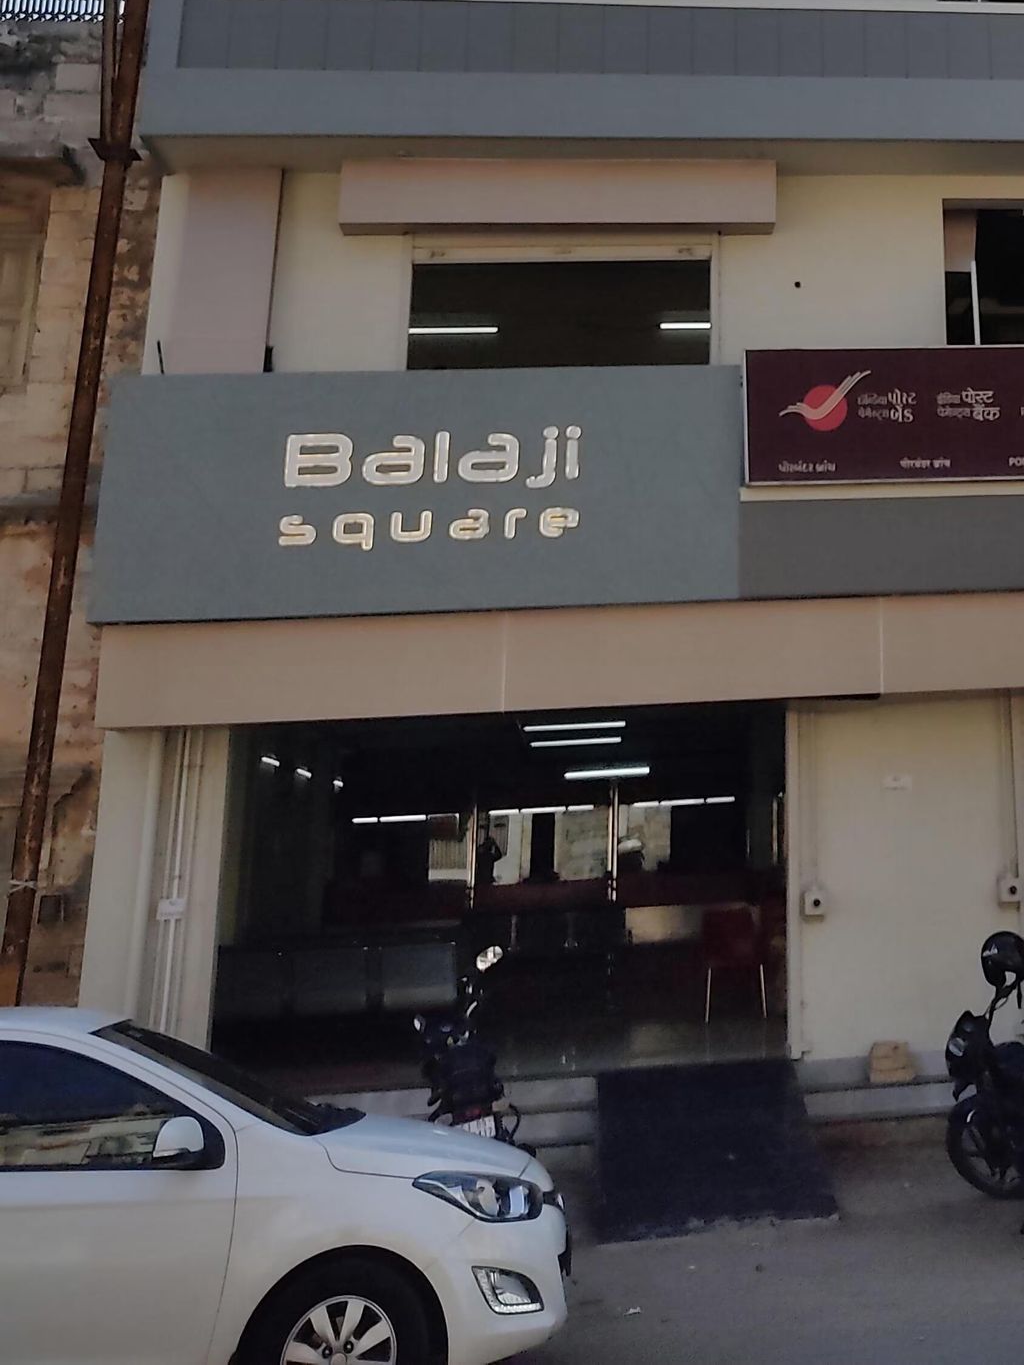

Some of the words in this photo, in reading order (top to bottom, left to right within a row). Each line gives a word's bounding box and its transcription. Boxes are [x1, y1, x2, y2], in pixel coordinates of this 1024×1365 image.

[961, 387, 994, 404] पोस्ट
[972, 404, 1000, 421] बैंक
[284, 425, 582, 489] Balaji
[278, 507, 580, 551] square
